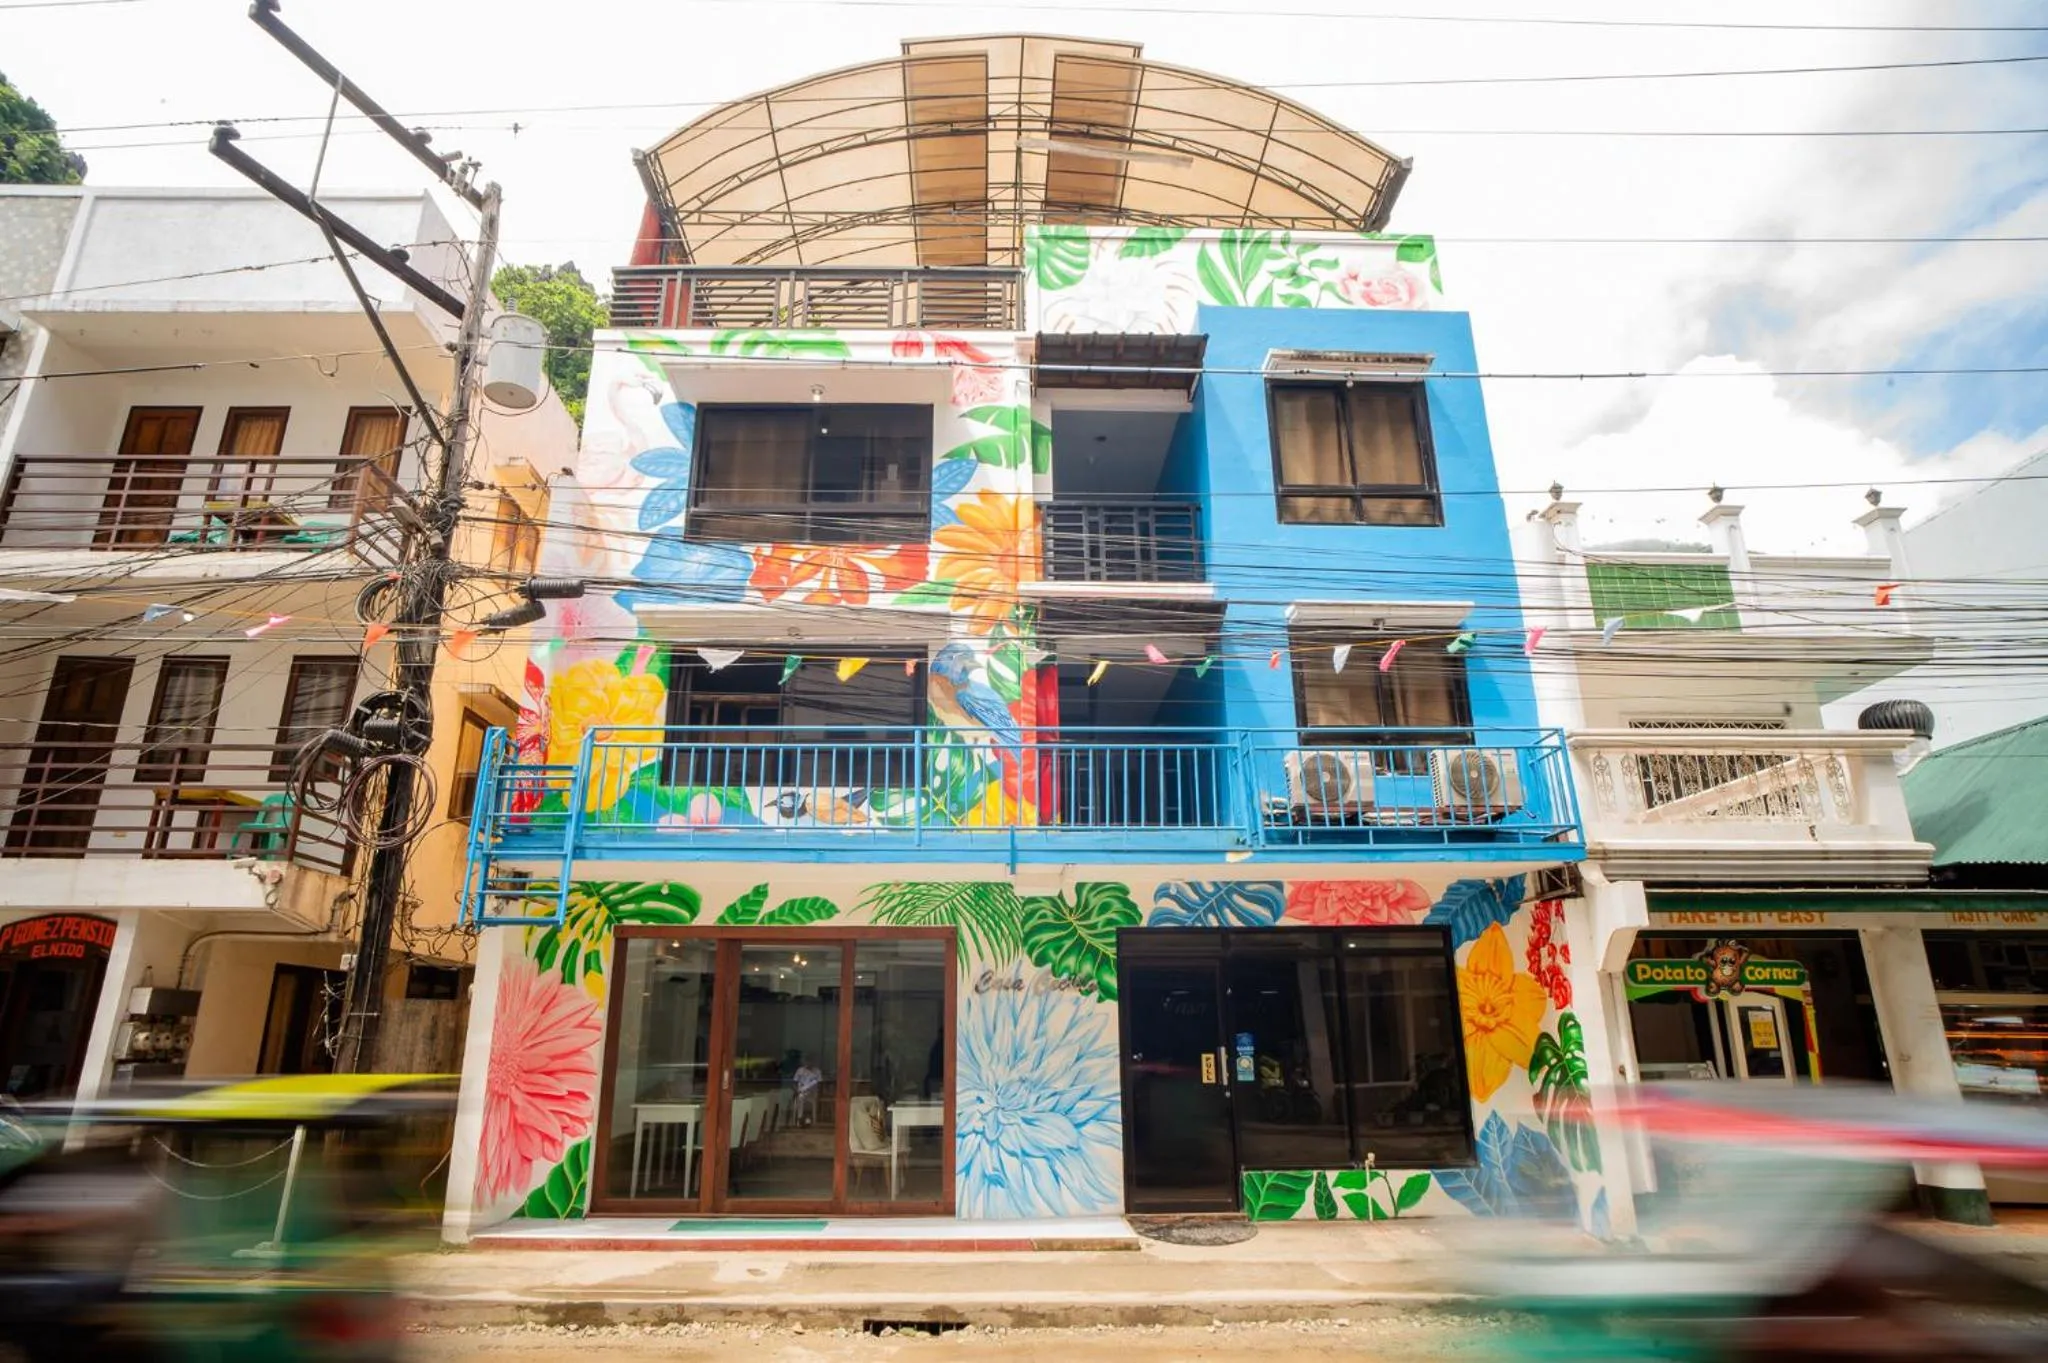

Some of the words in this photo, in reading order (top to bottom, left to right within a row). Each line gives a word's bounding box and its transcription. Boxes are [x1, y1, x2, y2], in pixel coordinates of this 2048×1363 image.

[60, 916, 116, 948] PENSIO
[1636, 963, 1708, 982] Potato
[1744, 966, 1799, 981] Corner
